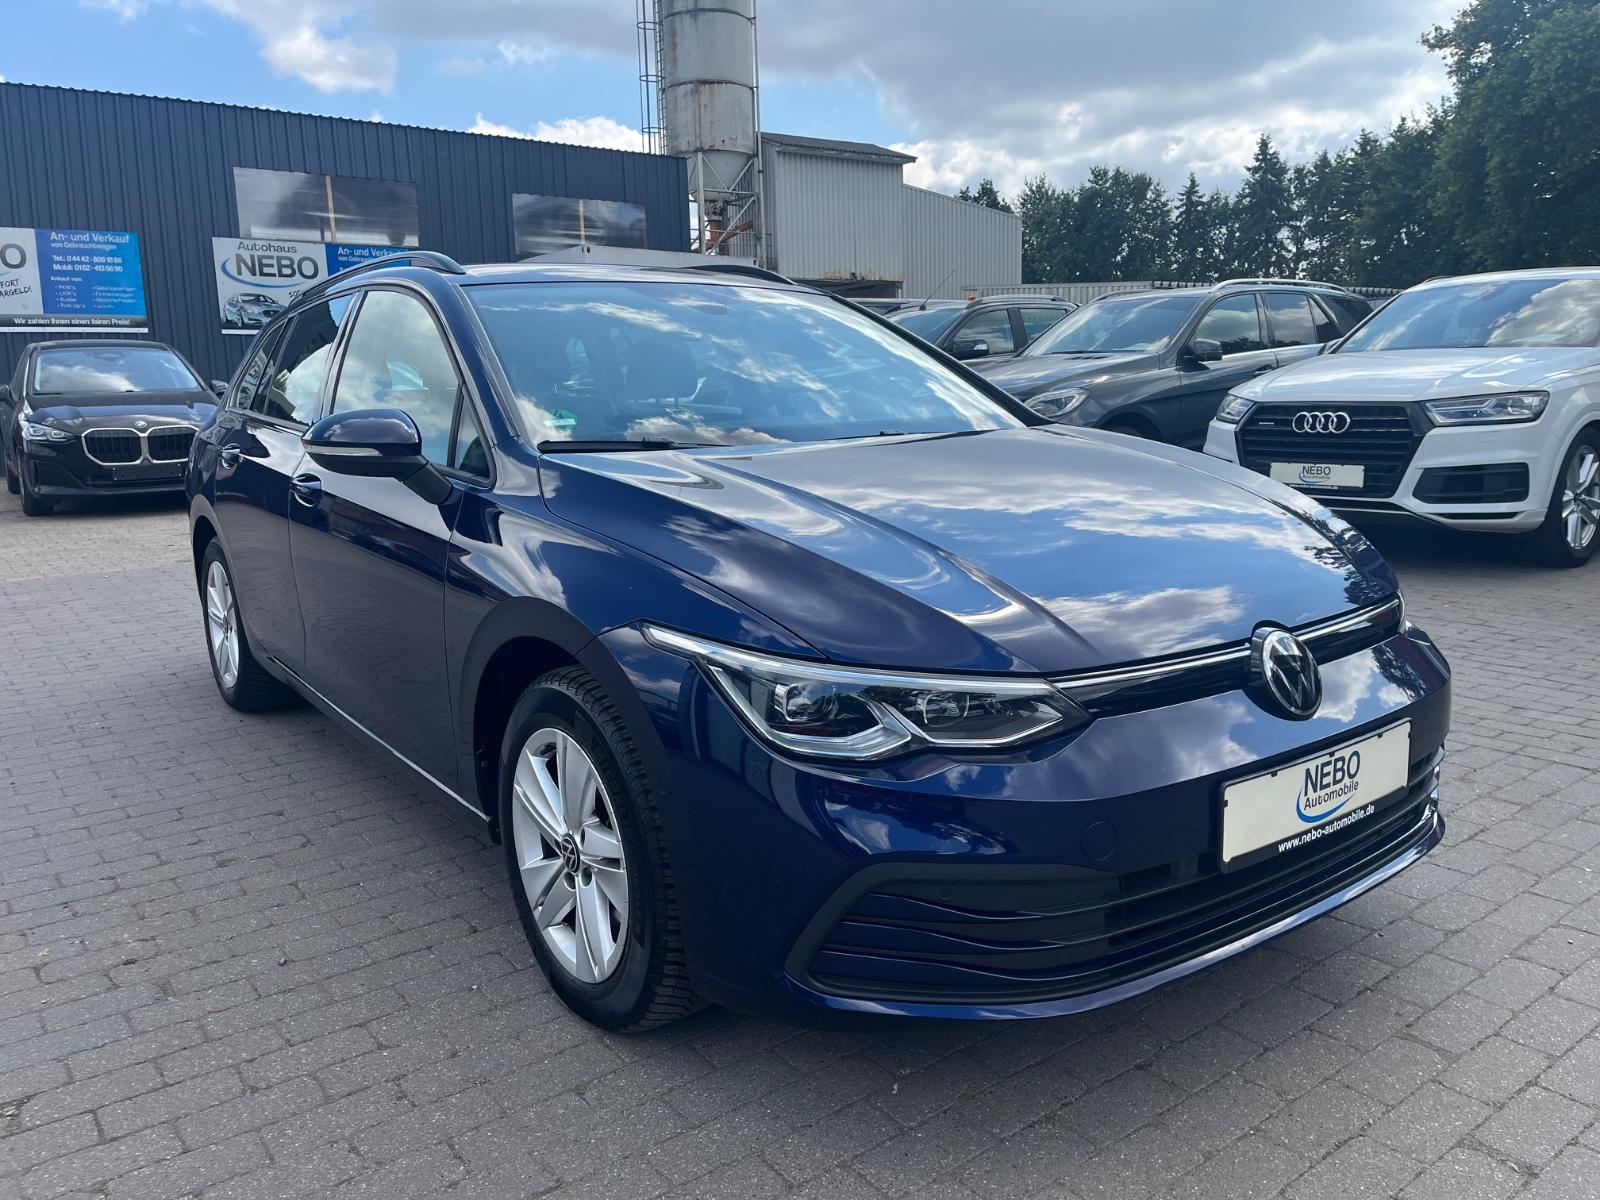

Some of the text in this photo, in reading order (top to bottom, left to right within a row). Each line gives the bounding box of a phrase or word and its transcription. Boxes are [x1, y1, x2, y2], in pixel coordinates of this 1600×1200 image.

[50, 231, 130, 243] An- und Verkauf
[237, 241, 298, 254] Autohaus
[337, 246, 352, 255] An-
[354, 248, 369, 256] und
[235, 253, 319, 280] NEBO
[1302, 466, 1331, 476] NEBO
[1304, 750, 1361, 797] NEBO
[1304, 780, 1359, 810] Automobile
[1278, 804, 1376, 853] www.nebo-automobile.de
